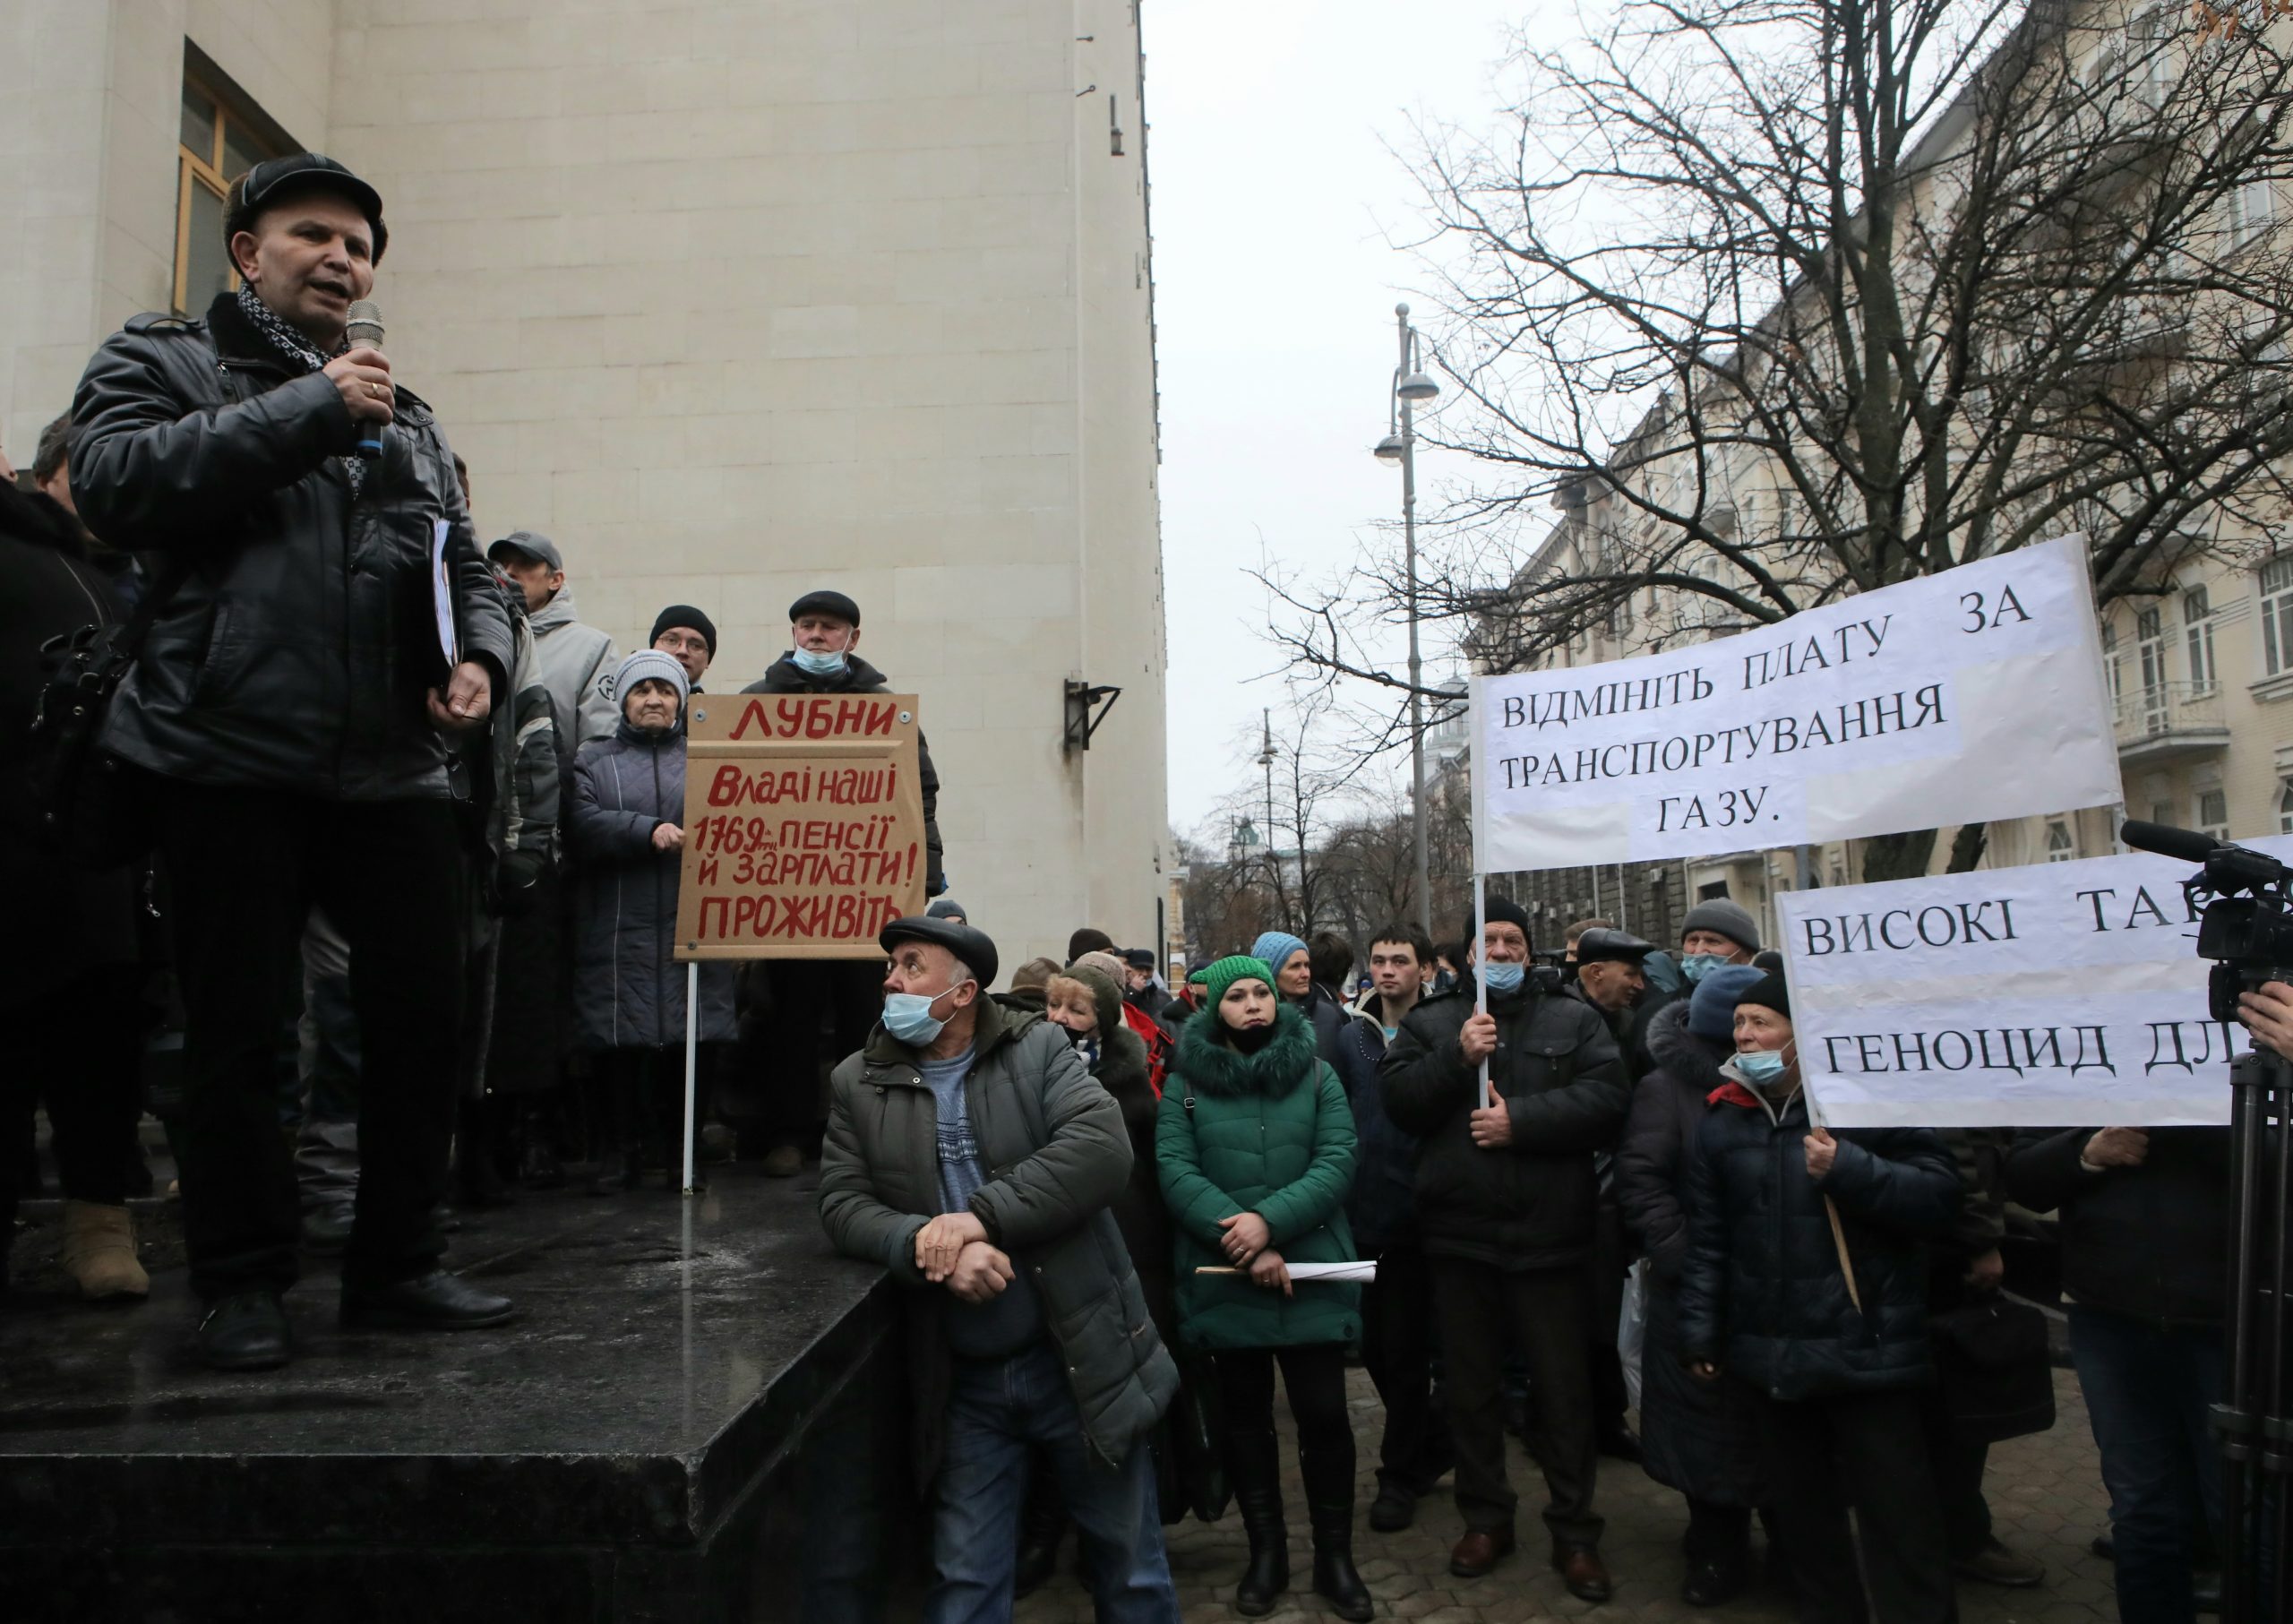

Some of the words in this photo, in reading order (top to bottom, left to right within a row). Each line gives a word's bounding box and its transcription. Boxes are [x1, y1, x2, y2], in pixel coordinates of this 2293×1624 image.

[1501, 666, 1714, 730] ВІДМІНІТЬ
[1743, 614, 1894, 691] ПЛАТУ
[1959, 582, 2032, 634] ЗА
[729, 698, 897, 741] ЛУБНИ
[1500, 682, 1949, 789] ТРАНСПОРТУВАННЯ
[708, 763, 812, 808] Владі
[817, 762, 897, 806] наші
[1655, 786, 1781, 832] ГАЗУ.
[693, 815, 767, 855] 1769
[1800, 898, 2020, 957] ВИСОКІ
[1822, 1025, 2117, 1079] ГЕНОЦИД
